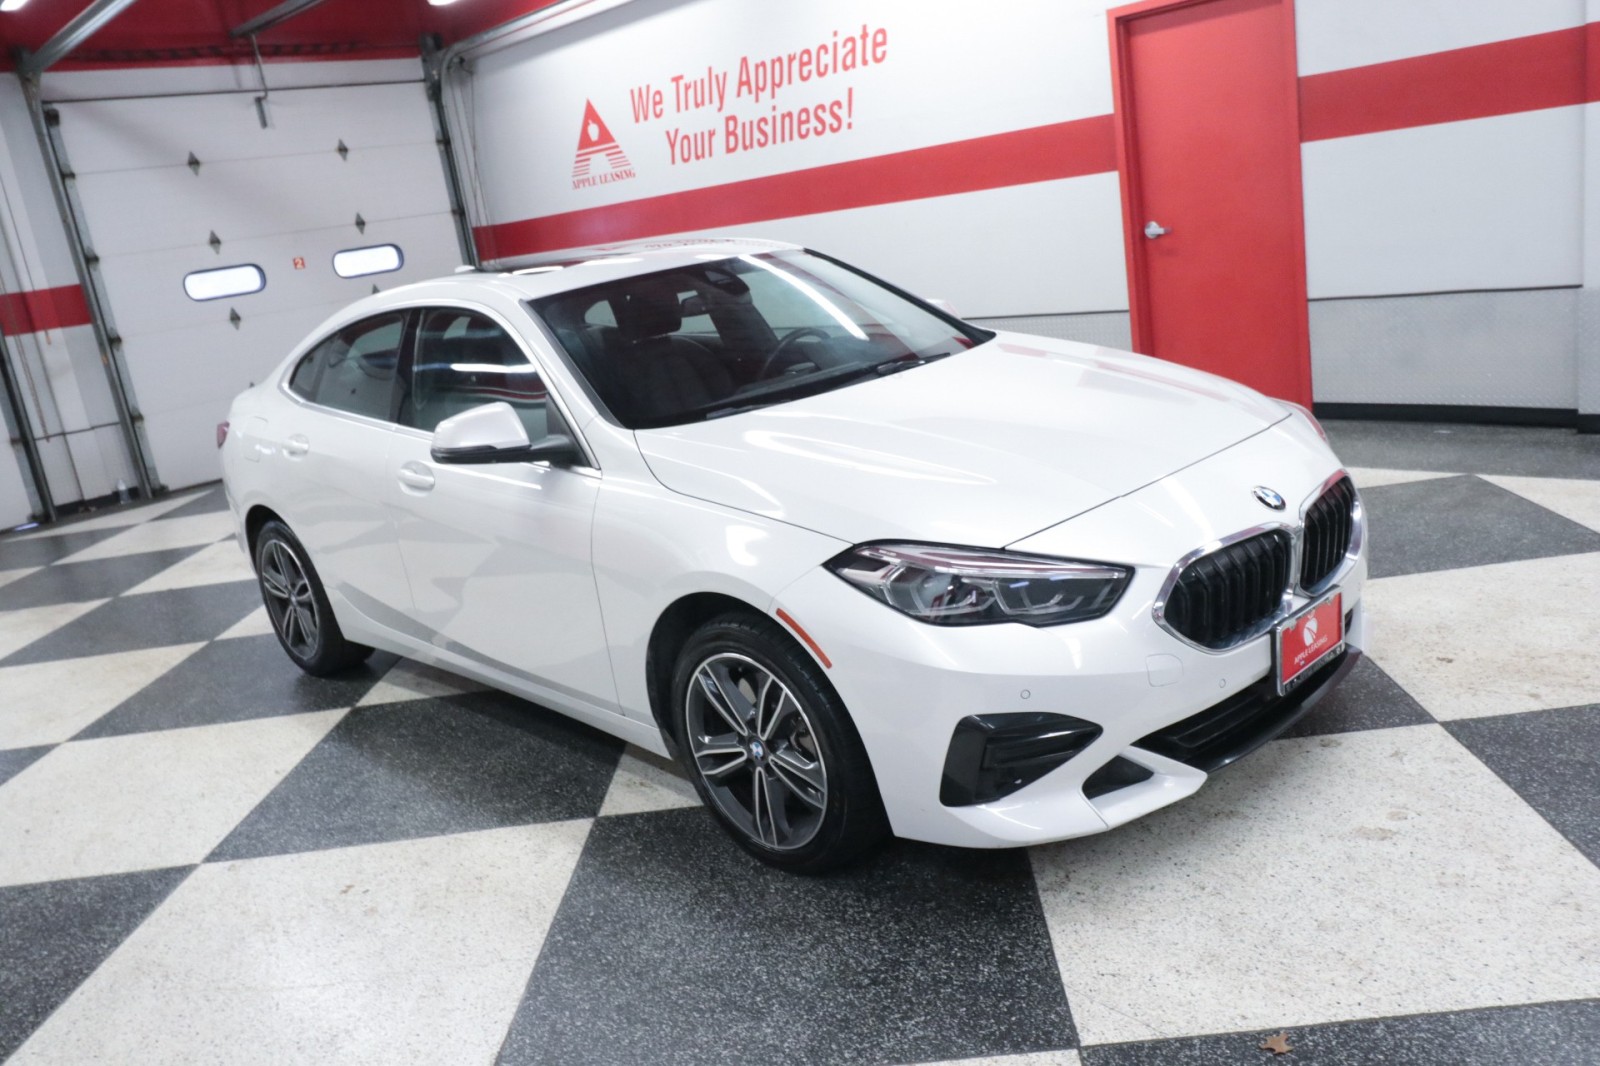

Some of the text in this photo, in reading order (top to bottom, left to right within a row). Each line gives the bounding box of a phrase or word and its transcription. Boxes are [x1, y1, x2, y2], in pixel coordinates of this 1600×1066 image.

[630, 24, 888, 124] We Truly Appreciate
[665, 87, 854, 165] Your Business!
[572, 167, 636, 190] APPLE LEASING
[294, 257, 304, 270] 2
